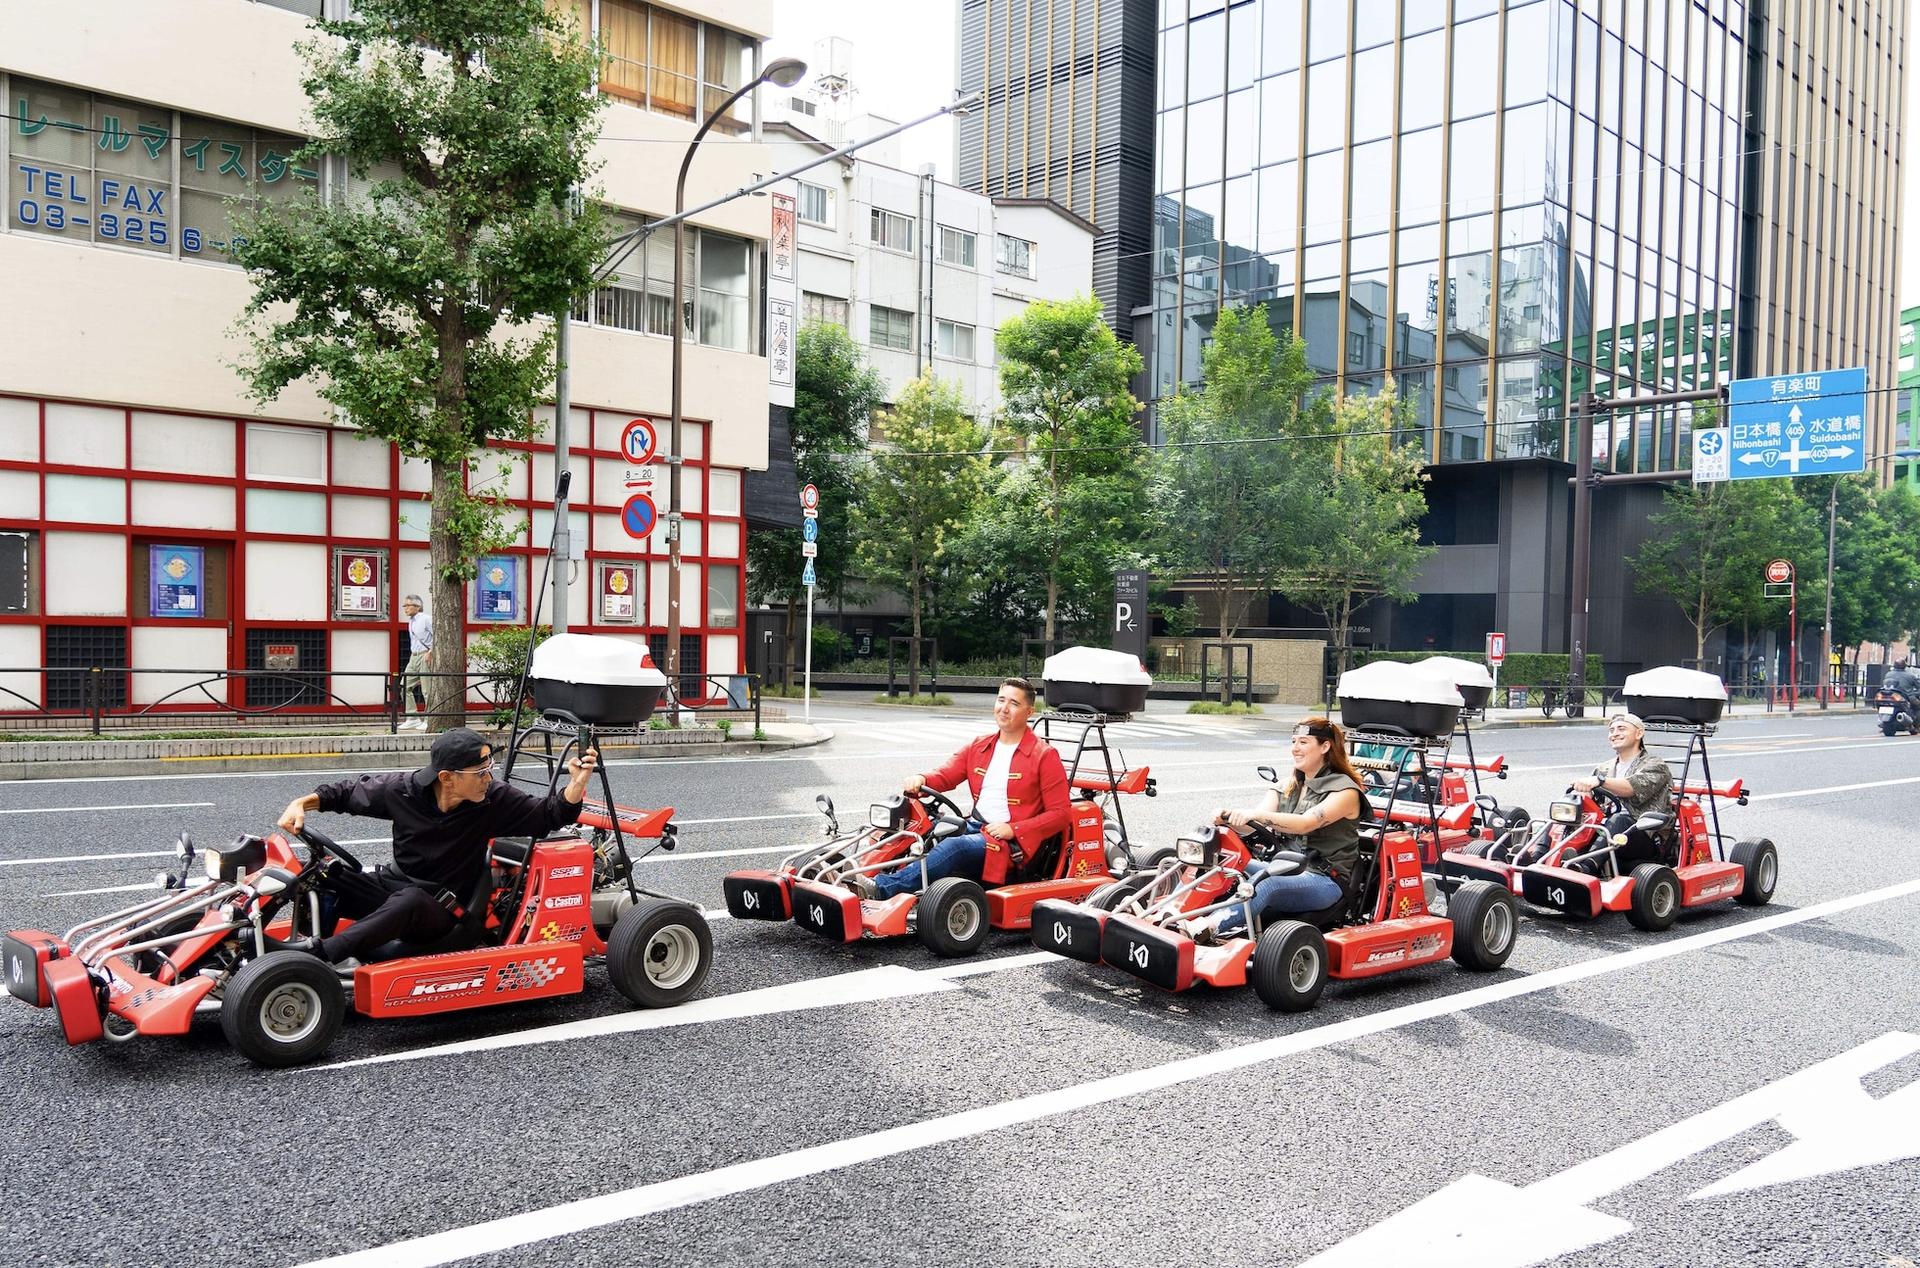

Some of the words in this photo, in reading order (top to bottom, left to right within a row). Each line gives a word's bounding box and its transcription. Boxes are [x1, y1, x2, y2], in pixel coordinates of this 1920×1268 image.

[17, 98, 320, 184] レールマイスター
[18, 164, 88, 205] TEL
[101, 178, 166, 217] FAX
[1770, 376, 1821, 396] 有楽町
[1733, 422, 1781, 440] 日本橋
[1787, 425, 1804, 437] 405
[1809, 415, 1861, 433] 水道橋
[1733, 438, 1782, 449] Nihonbashi
[1809, 431, 1861, 443] Suidobashi
[1764, 451, 1776, 463] 17
[1810, 448, 1829, 459] 405
[1116, 602, 1132, 632] P
[411, 977, 485, 996] Kart
[384, 989, 485, 1007] streetpower
